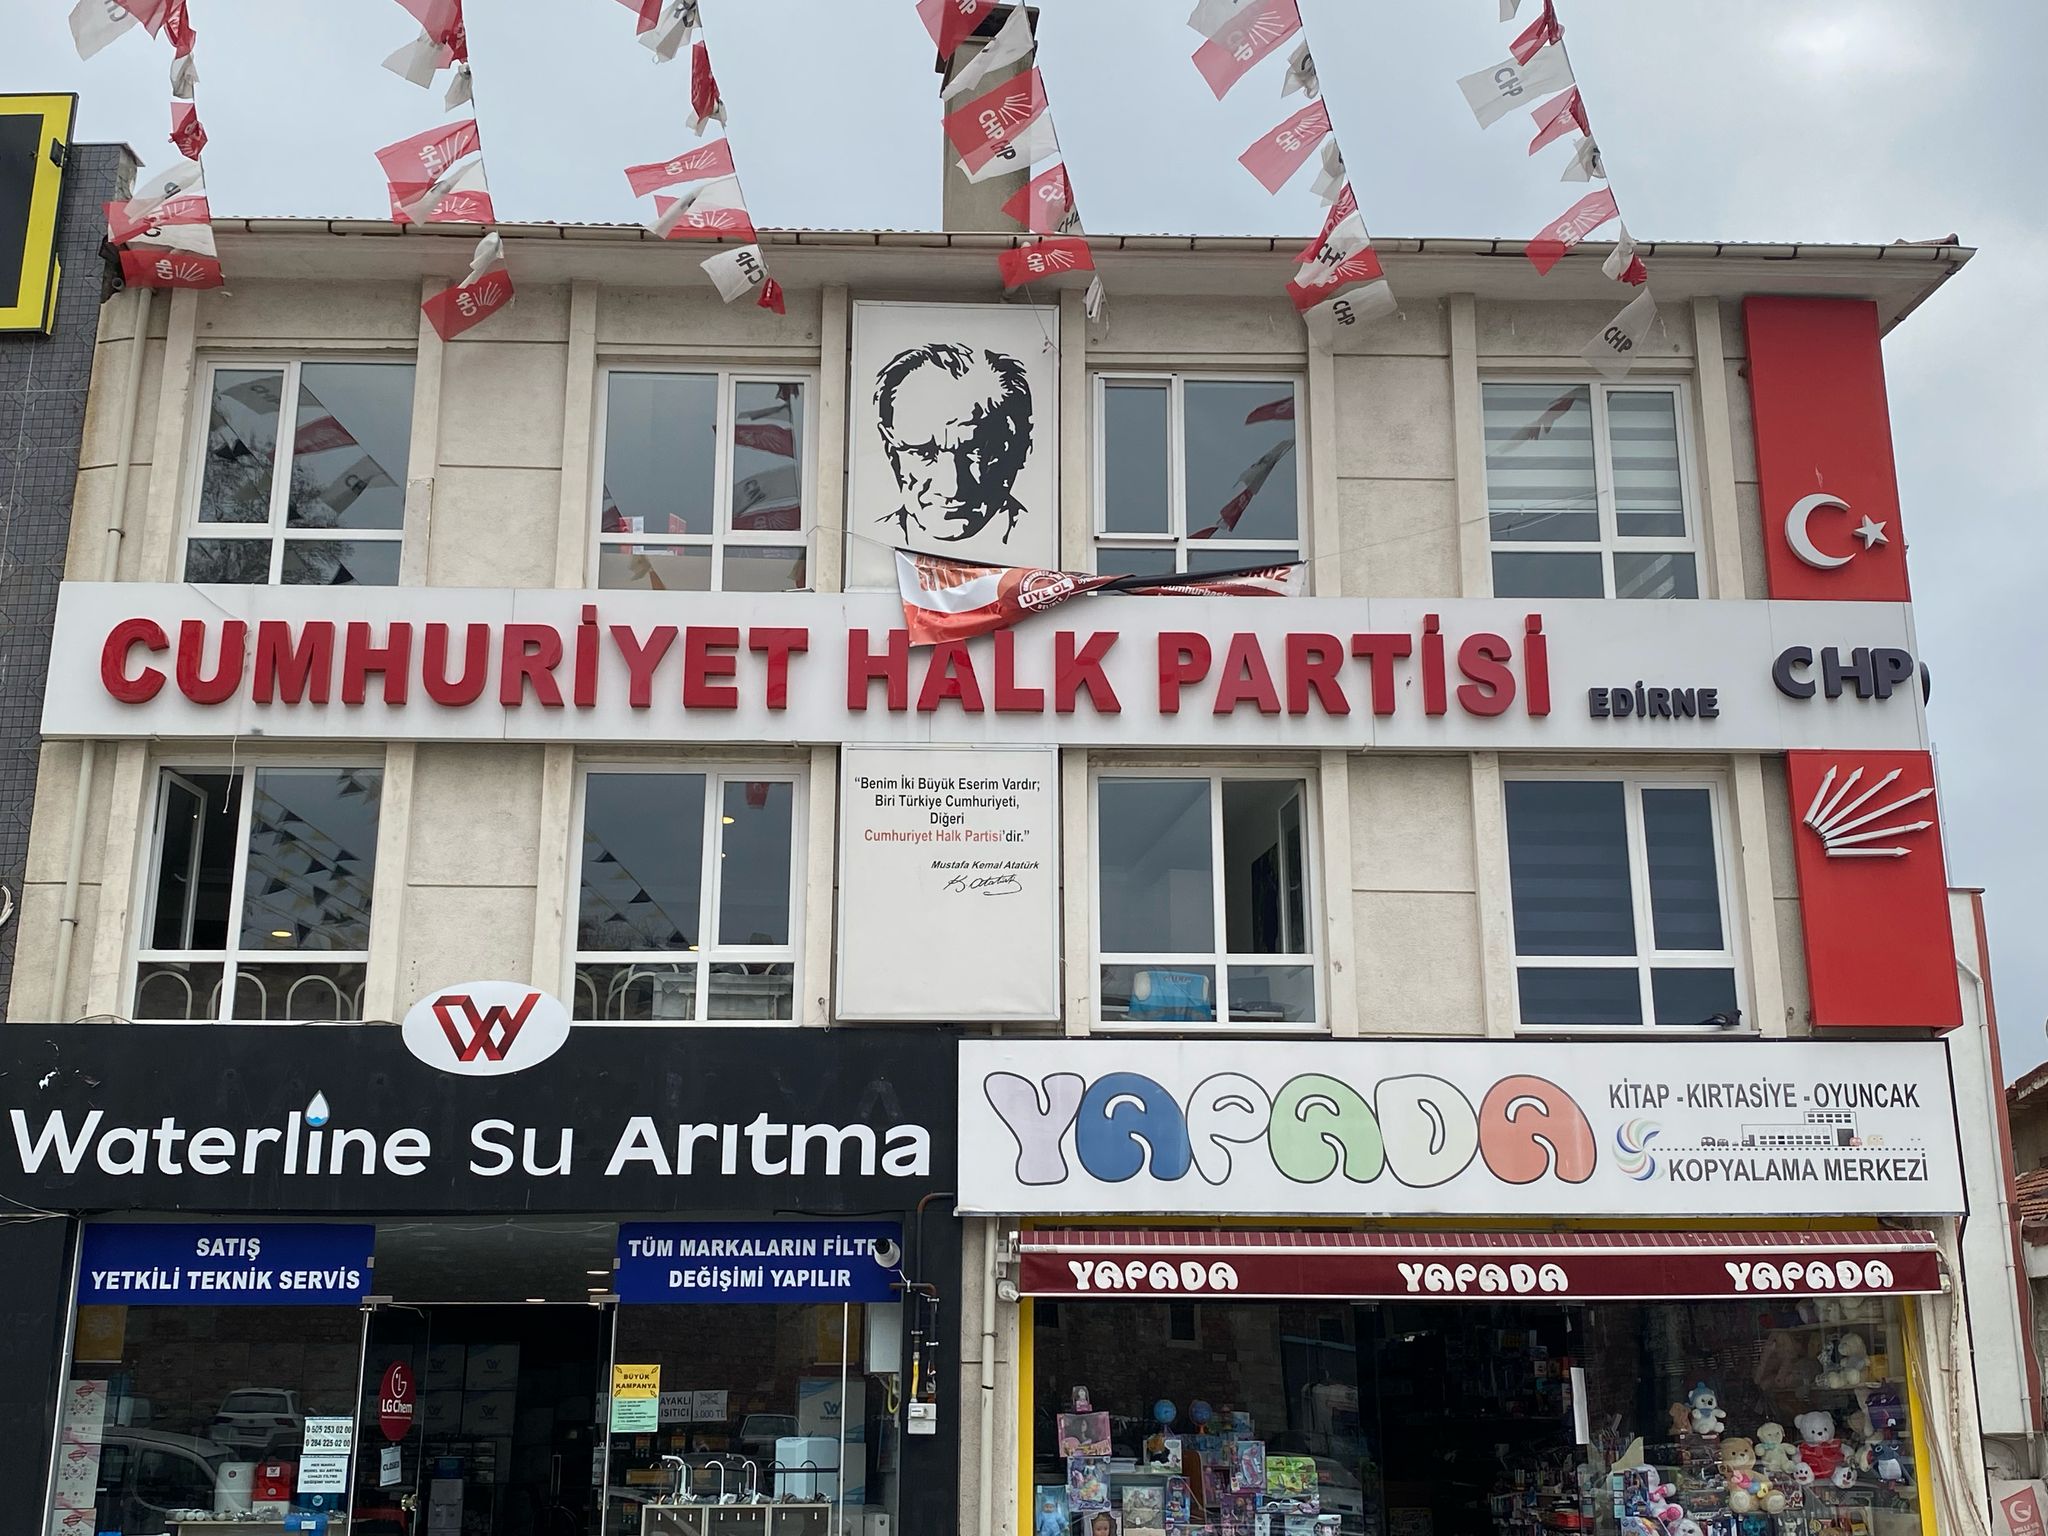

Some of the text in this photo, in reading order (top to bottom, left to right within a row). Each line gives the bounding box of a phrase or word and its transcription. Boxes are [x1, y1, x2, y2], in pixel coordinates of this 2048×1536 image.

[1494, 67, 1524, 98] CHP
[978, 110, 1004, 141] CHP
[1275, 130, 1301, 153] CHP
[1027, 253, 1045, 273] CHP
[1333, 300, 1355, 326] CHP
[1604, 326, 1632, 353] CHP
[1052, 582, 1070, 594] OL
[101, 603, 1551, 717] CUMHURİYET HALK PARTİSİ
[1772, 646, 1914, 701] CHP
[1587, 680, 1720, 720] EDİRNE
[854, 774, 1040, 793] “Benim İki Büyük Eserim Vardır;
[875, 794, 1019, 810] Biri Türkiye Cumhuriyeti,
[930, 812, 964, 827] Diğeri
[864, 829, 932, 845] Cumhuriyet
[936, 829, 961, 842] Halk
[931, 860, 1040, 870] Mustafa Kemal Atatürk
[1608, 1077, 1670, 1109] KİTAP
[9, 1090, 931, 1177] Waterline Su Arıtma
[983, 1071, 1597, 1188] YAPADA
[1668, 1152, 1929, 1183] KOPYALAMA MERKEZİ
[196, 1237, 261, 1260] SATIŞ
[628, 1235, 893, 1258] TÜM MARKALARIN FİLTR
[91, 1265, 360, 1290] YETKİLİ TEKNİK SERVİS
[669, 1265, 851, 1292] DEĞİŞİMİ YAPILIR
[1068, 1259, 1239, 1292] YAPADA
[1398, 1261, 1569, 1293] YAPADA
[1724, 1260, 1894, 1291] YAPADA
[381, 1398, 413, 1414] LG Chem
[322, 1439, 334, 1447] 225
